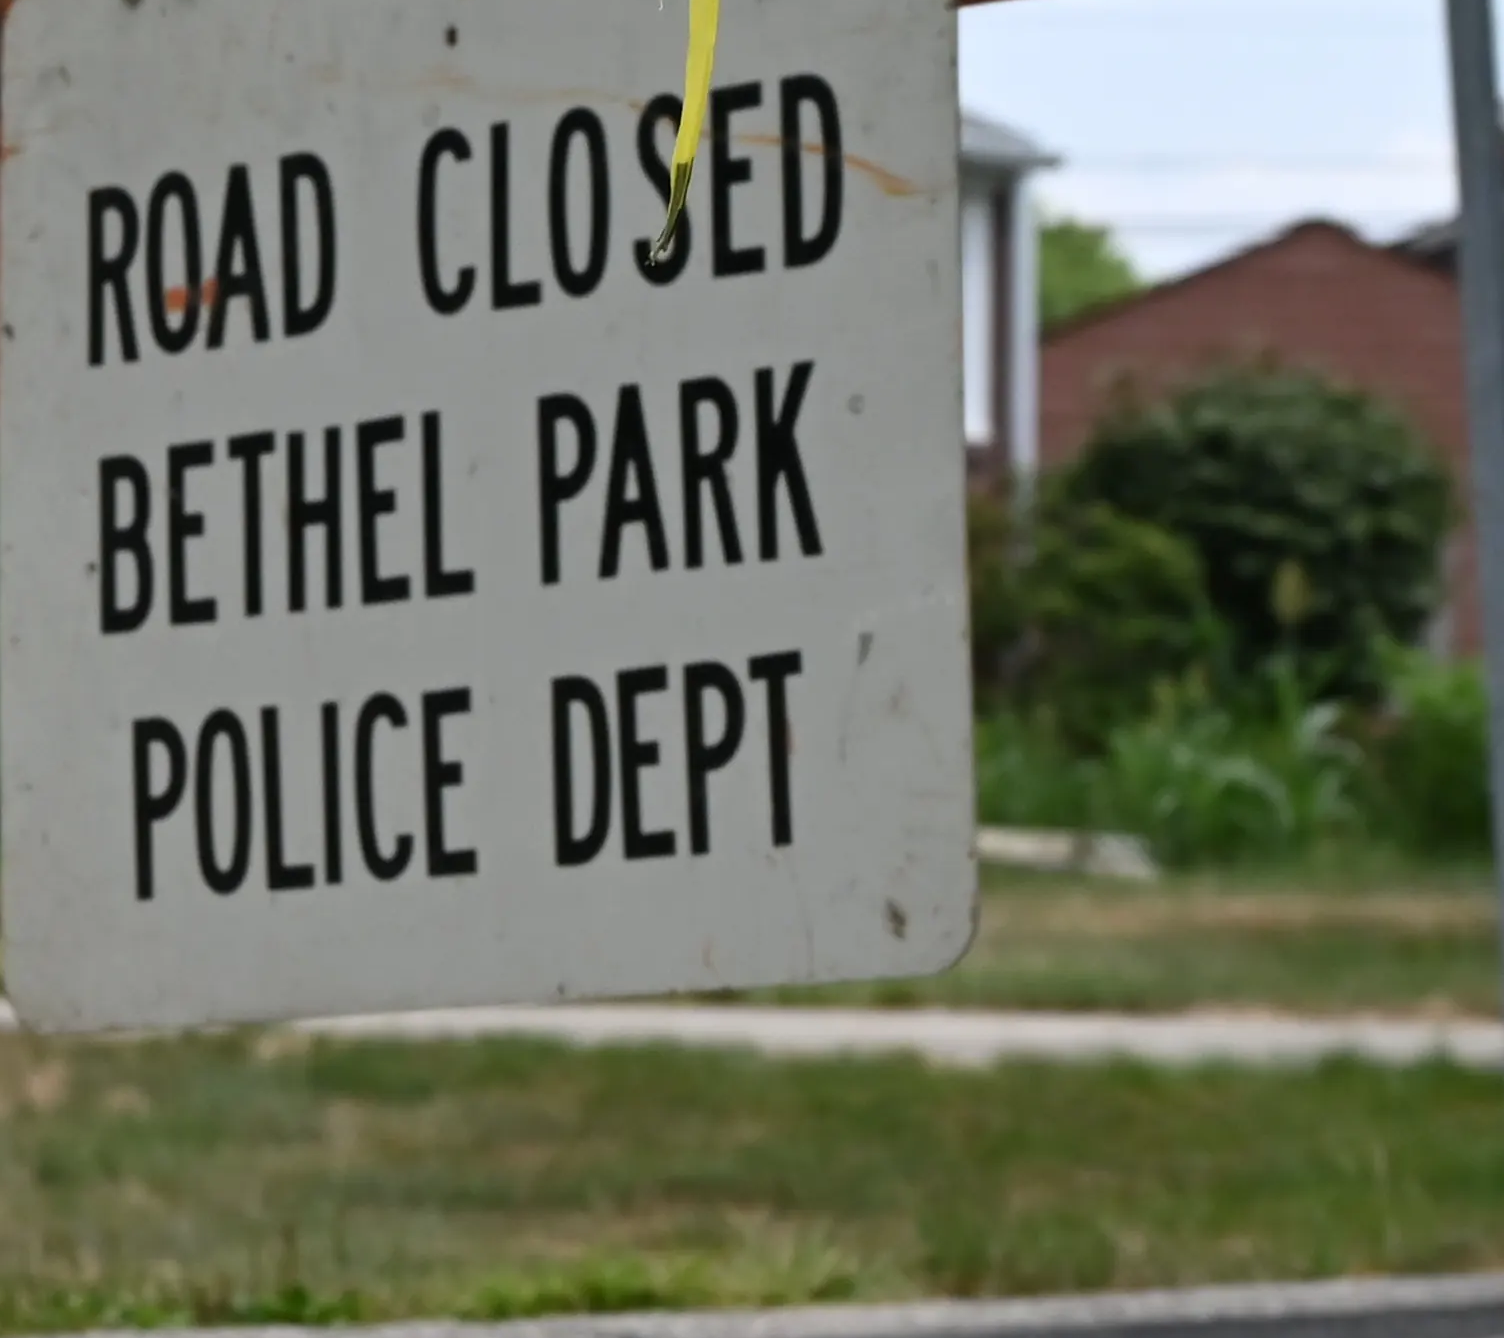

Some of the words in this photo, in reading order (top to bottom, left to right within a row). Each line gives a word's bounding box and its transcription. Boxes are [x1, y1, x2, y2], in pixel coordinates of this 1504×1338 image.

[87, 152, 337, 367] ROAD
[416, 73, 844, 316] CLOSED
[98, 410, 475, 635] BETHEL
[536, 360, 824, 586] PARK
[132, 686, 478, 901] POLICE
[550, 649, 803, 868] DEPT
